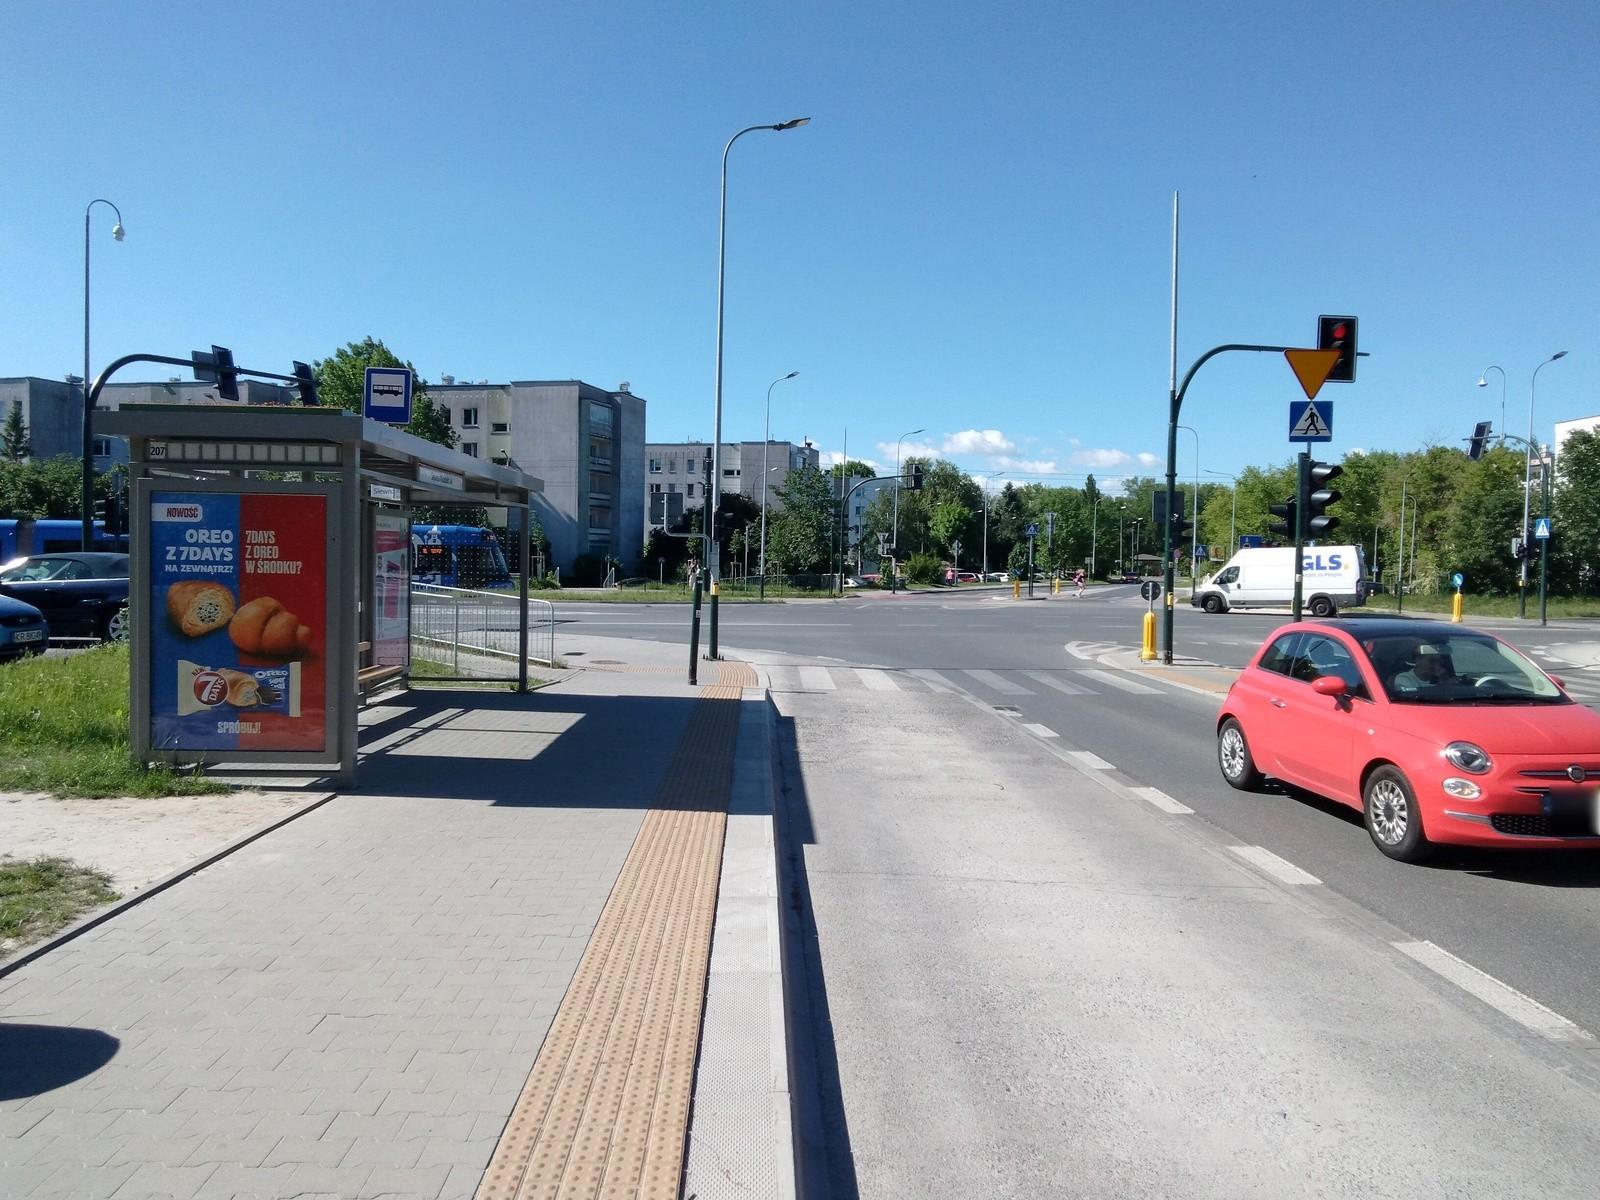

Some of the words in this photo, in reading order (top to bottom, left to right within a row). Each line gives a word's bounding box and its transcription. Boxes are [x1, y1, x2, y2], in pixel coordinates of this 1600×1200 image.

[150, 446, 165, 456] 207
[185, 529, 234, 543] OREO
[245, 530, 276, 544] 7DAYS
[165, 546, 177, 560] Z
[180, 546, 234, 561] 7DAYS
[245, 545, 253, 559] Z
[253, 545, 279, 559] OREO
[164, 564, 178, 572] NA
[180, 564, 233, 575] ZEWNĄTRZ?
[245, 560, 256, 574] W
[256, 558, 302, 574] ŚRODKU?
[254, 670, 288, 679] OREO
[198, 675, 218, 702] 7
[208, 679, 225, 702] DAYS
[217, 719, 262, 734] SPRÓBUJ!
